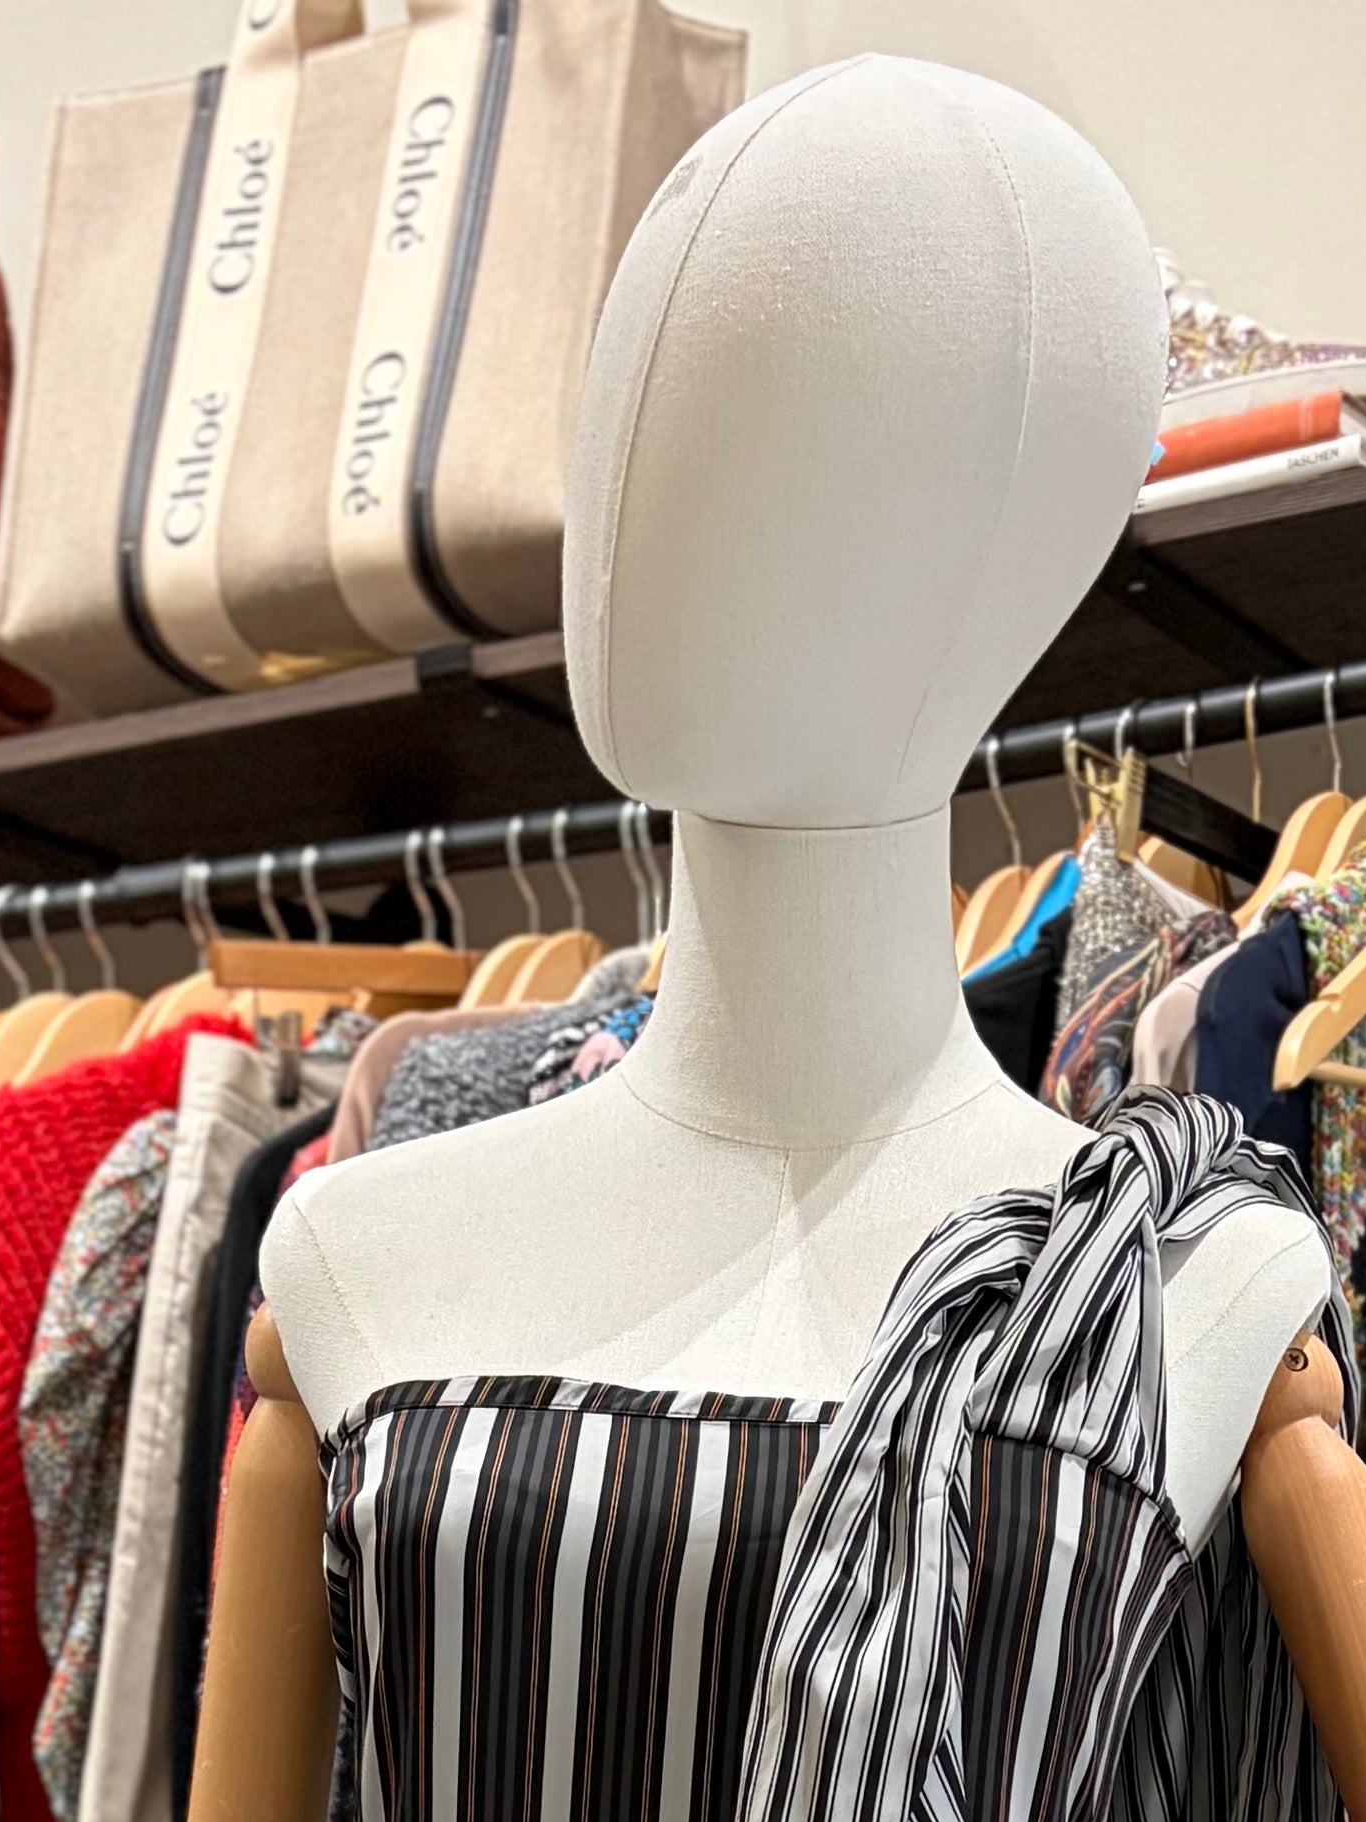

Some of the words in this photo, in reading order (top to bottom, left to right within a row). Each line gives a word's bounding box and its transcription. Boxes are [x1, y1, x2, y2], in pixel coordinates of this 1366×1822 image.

[209, 139, 273, 295] Chloé
[389, 96, 455, 251] Chloé
[162, 392, 230, 547] Chloé
[341, 352, 406, 516] Chloé
[1288, 447, 1339, 469] TASCHEN
